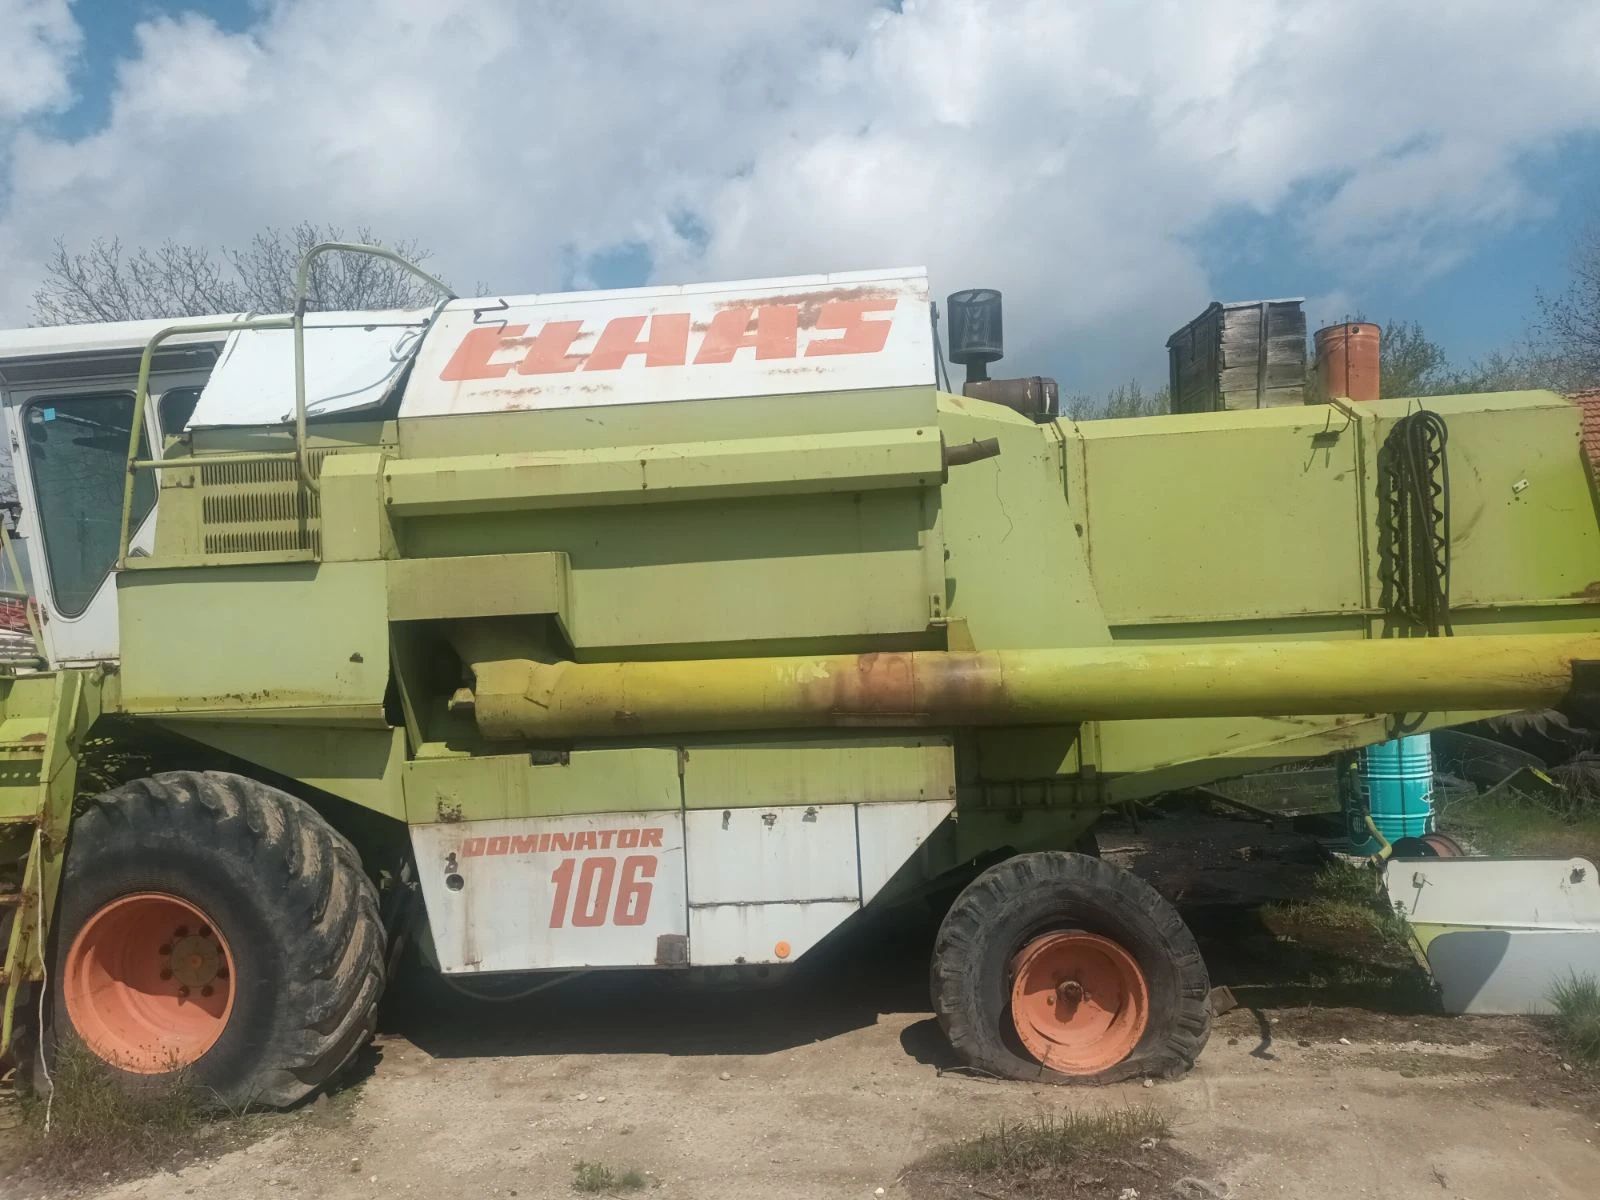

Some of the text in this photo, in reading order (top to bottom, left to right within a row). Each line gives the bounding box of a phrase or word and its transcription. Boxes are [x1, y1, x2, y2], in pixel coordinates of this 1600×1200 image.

[440, 298, 897, 381] CLAAS
[464, 829, 664, 857] DOMINATOR
[550, 857, 658, 928] 106
